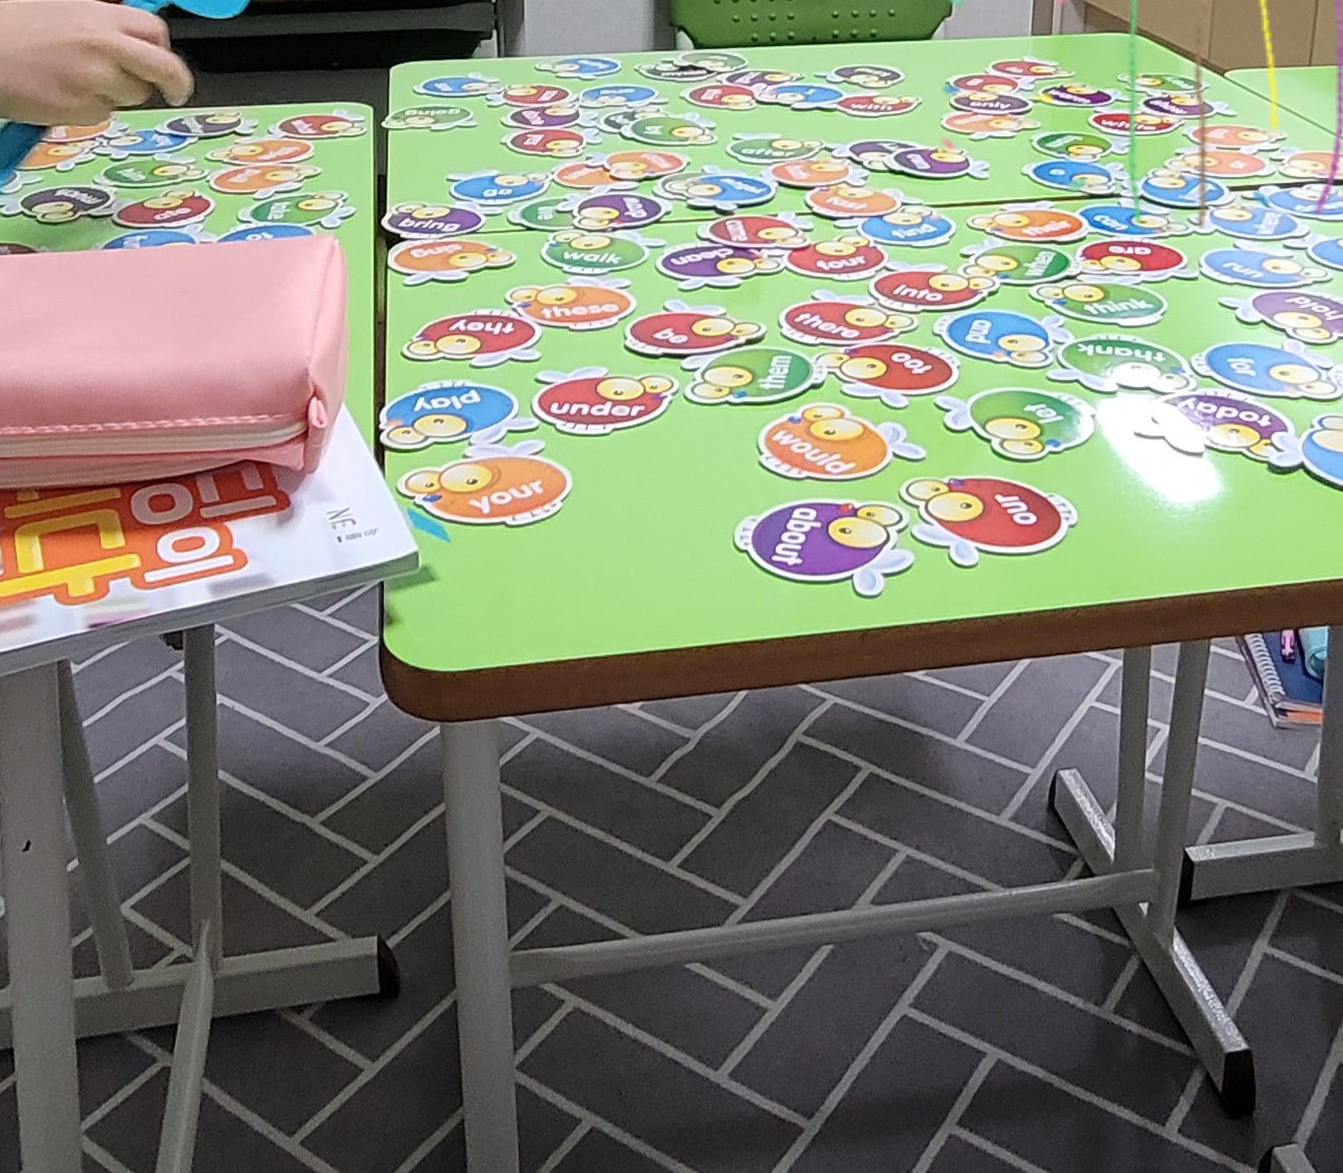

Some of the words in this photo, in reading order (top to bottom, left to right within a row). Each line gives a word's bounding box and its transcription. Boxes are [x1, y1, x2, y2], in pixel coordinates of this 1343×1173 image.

[483, 188, 513, 197] go
[397, 218, 462, 233] bring
[562, 250, 623, 265] walk
[816, 255, 866, 272] four
[1222, 262, 1264, 279] run
[540, 301, 619, 320] these
[1083, 297, 1153, 317] think
[448, 318, 515, 336] they
[793, 311, 861, 339] there
[652, 328, 689, 344] be
[1077, 342, 1166, 363] thank
[758, 354, 792, 391] them
[891, 351, 932, 376] too
[1226, 356, 1258, 378] for
[413, 388, 481, 412] play
[550, 398, 647, 418] under
[1023, 402, 1066, 426] let
[1177, 397, 1273, 426] today
[771, 428, 857, 476] would
[468, 477, 545, 516] your
[993, 492, 1039, 527] our
[771, 506, 824, 567] about
